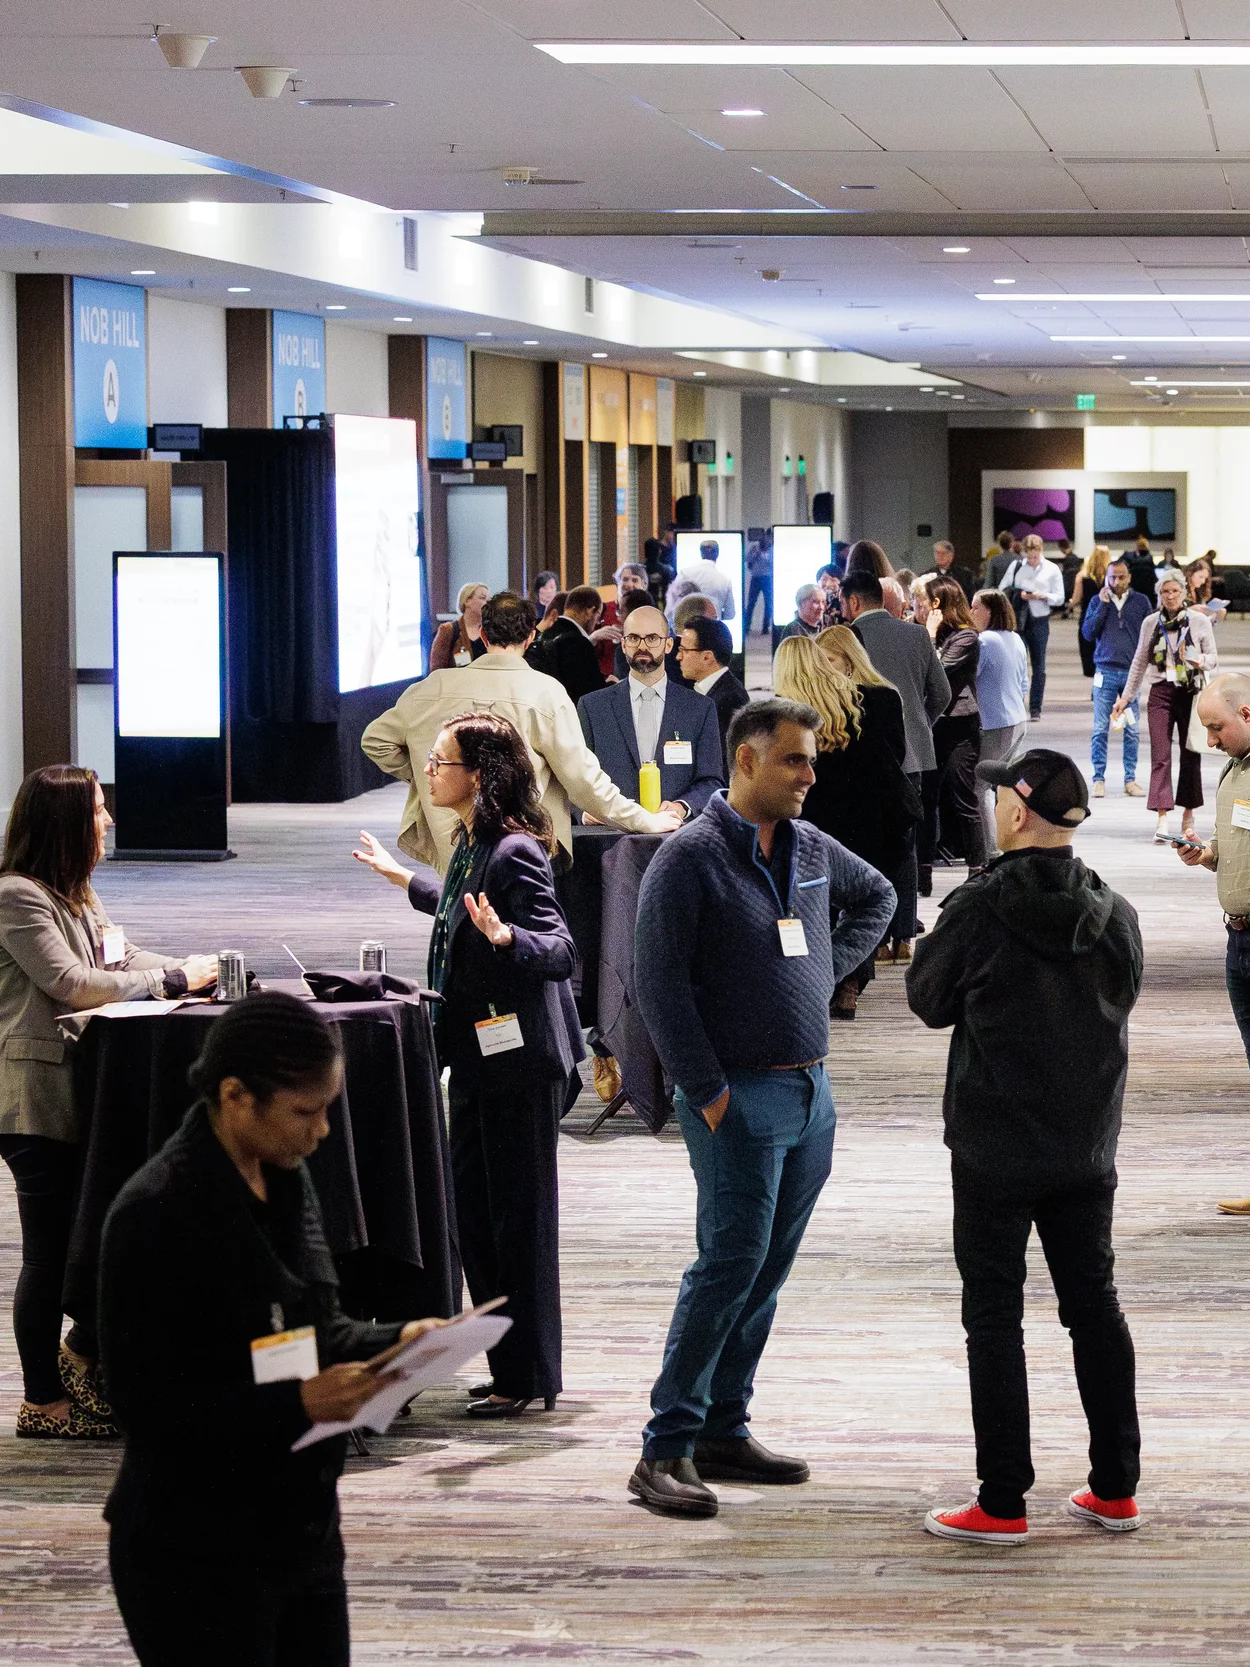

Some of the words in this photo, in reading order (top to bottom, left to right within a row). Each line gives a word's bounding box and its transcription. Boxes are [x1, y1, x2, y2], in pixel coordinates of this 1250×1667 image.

[80, 305, 109, 345] NOB
[112, 310, 140, 348] HILL
[278, 332, 300, 367] NOB
[301, 337, 321, 369] HILL
[106, 372, 116, 408] A
